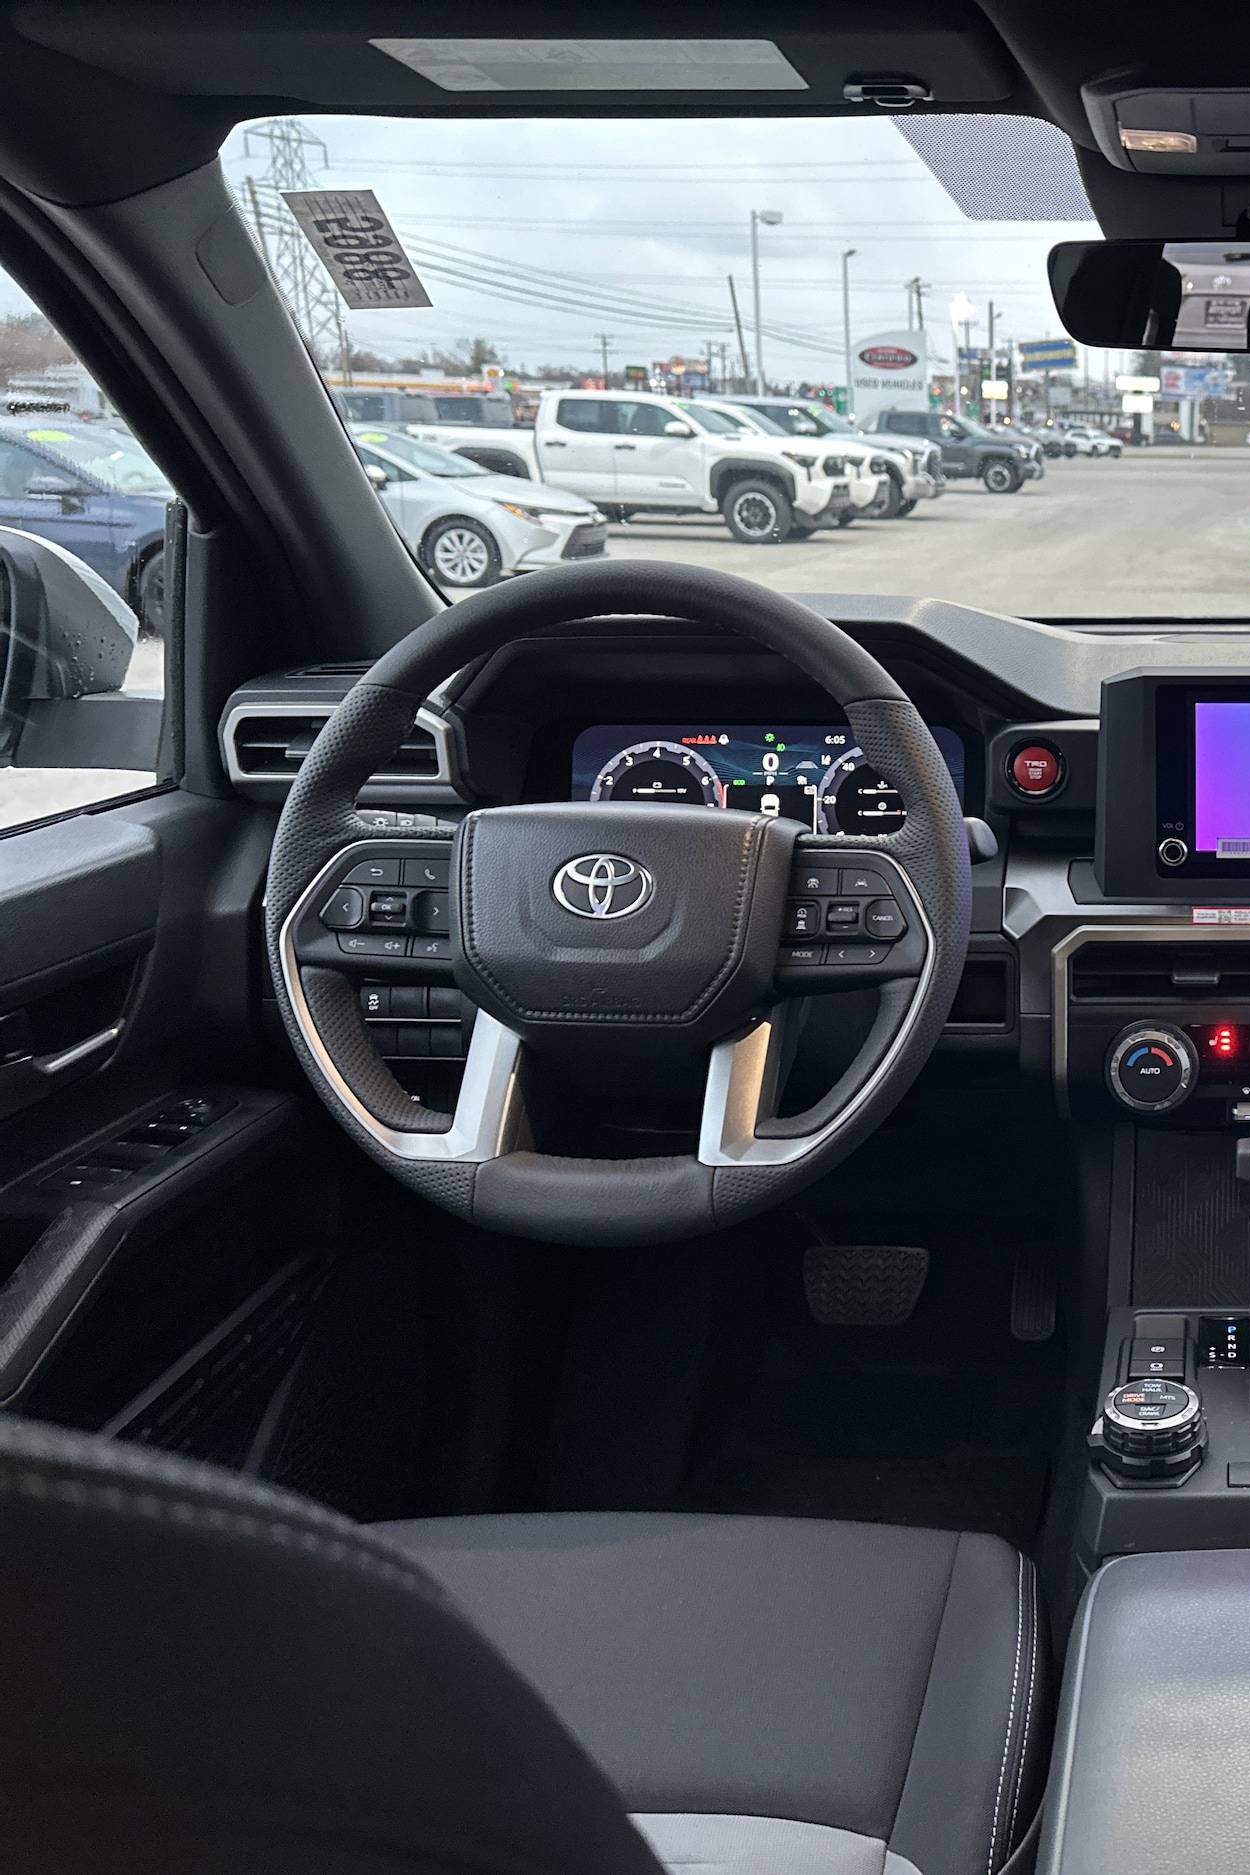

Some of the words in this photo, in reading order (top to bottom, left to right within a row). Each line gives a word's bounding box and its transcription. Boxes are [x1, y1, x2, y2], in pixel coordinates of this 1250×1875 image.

[856, 378, 879, 388] USED
[880, 378, 924, 391] VEHICLES
[825, 736, 846, 744] 6:05
[653, 750, 660, 758] 4
[626, 756, 633, 766] 3
[682, 756, 690, 766] 5
[762, 753, 779, 771] 0
[842, 763, 855, 771] 40
[606, 776, 613, 785] 2
[701, 776, 709, 785] 6
[766, 776, 775, 786] P
[824, 796, 836, 804] 20
